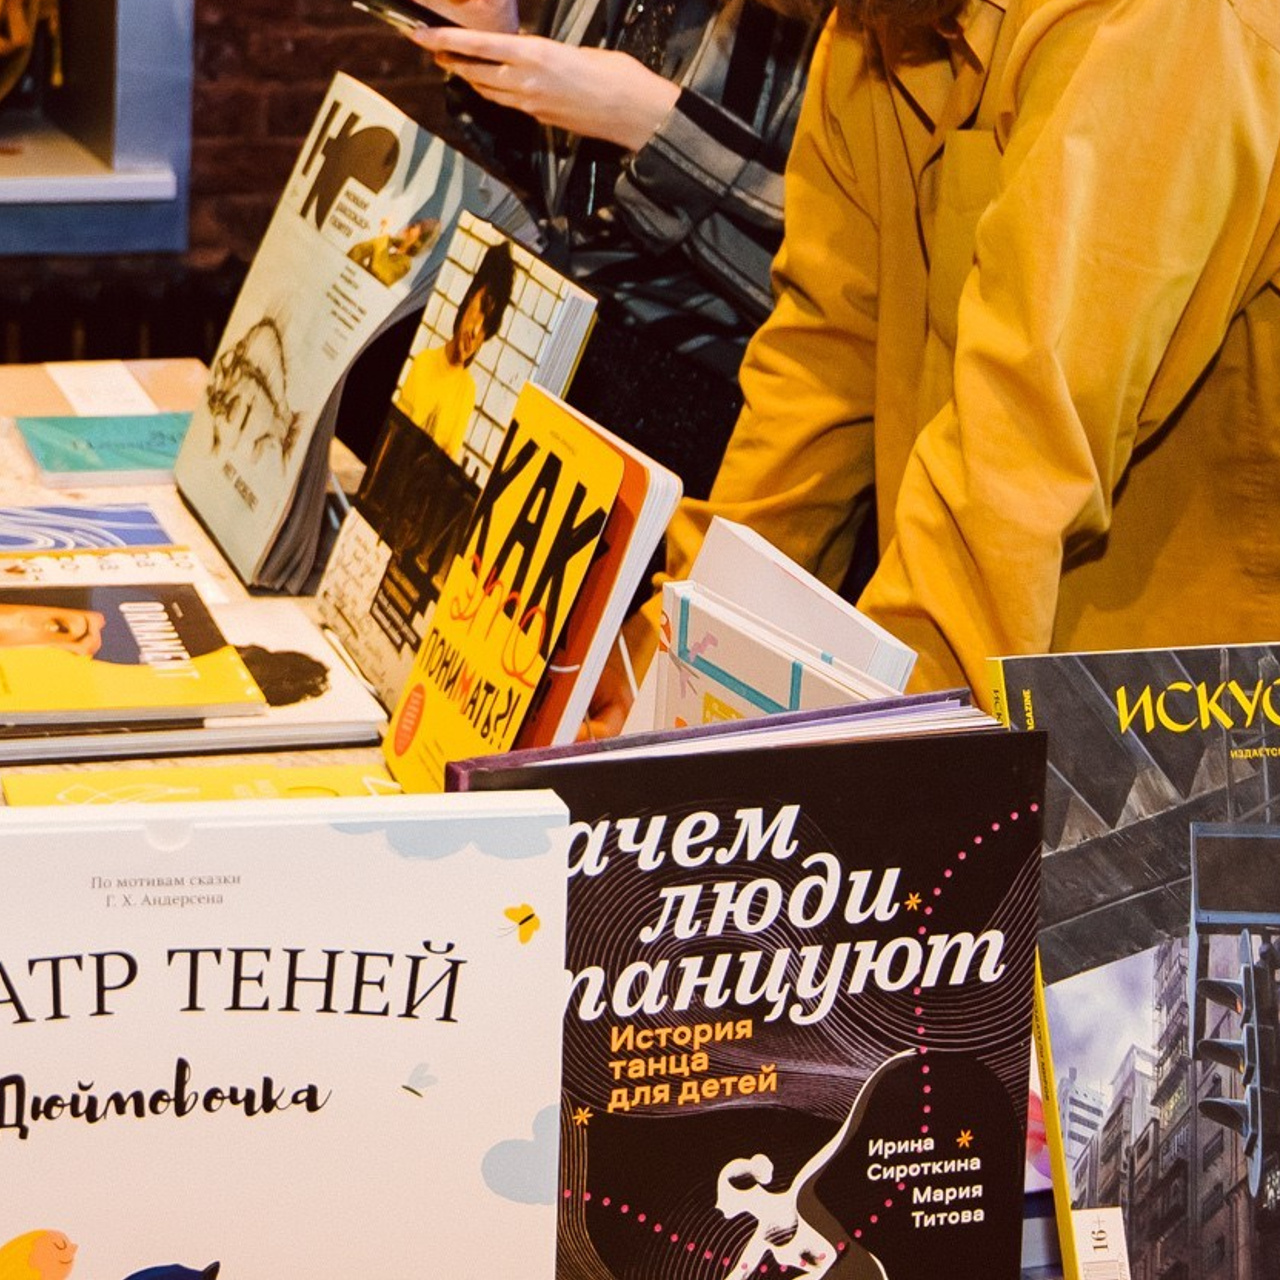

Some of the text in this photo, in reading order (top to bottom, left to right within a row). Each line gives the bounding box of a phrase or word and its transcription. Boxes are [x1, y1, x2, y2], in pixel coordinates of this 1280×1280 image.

[463, 418, 607, 663] КАК
[420, 628, 520, 749] ПОНИМАТЬ?!
[91, 874, 241, 889] По мотивам сказки
[106, 893, 224, 908] Г. Х. Андерсена
[639, 852, 902, 943] люди
[168, 940, 468, 1024] ТЕНЕЙ
[610, 1019, 753, 1053] История
[608, 1051, 710, 1080] танца
[607, 1063, 778, 1112] для детей
[867, 1134, 935, 1158] Ирина
[866, 1153, 982, 1182] Сироткина
[911, 1182, 984, 1205] Мария
[911, 1205, 985, 1228] Титова
[1090, 1214, 1109, 1253] 16+
